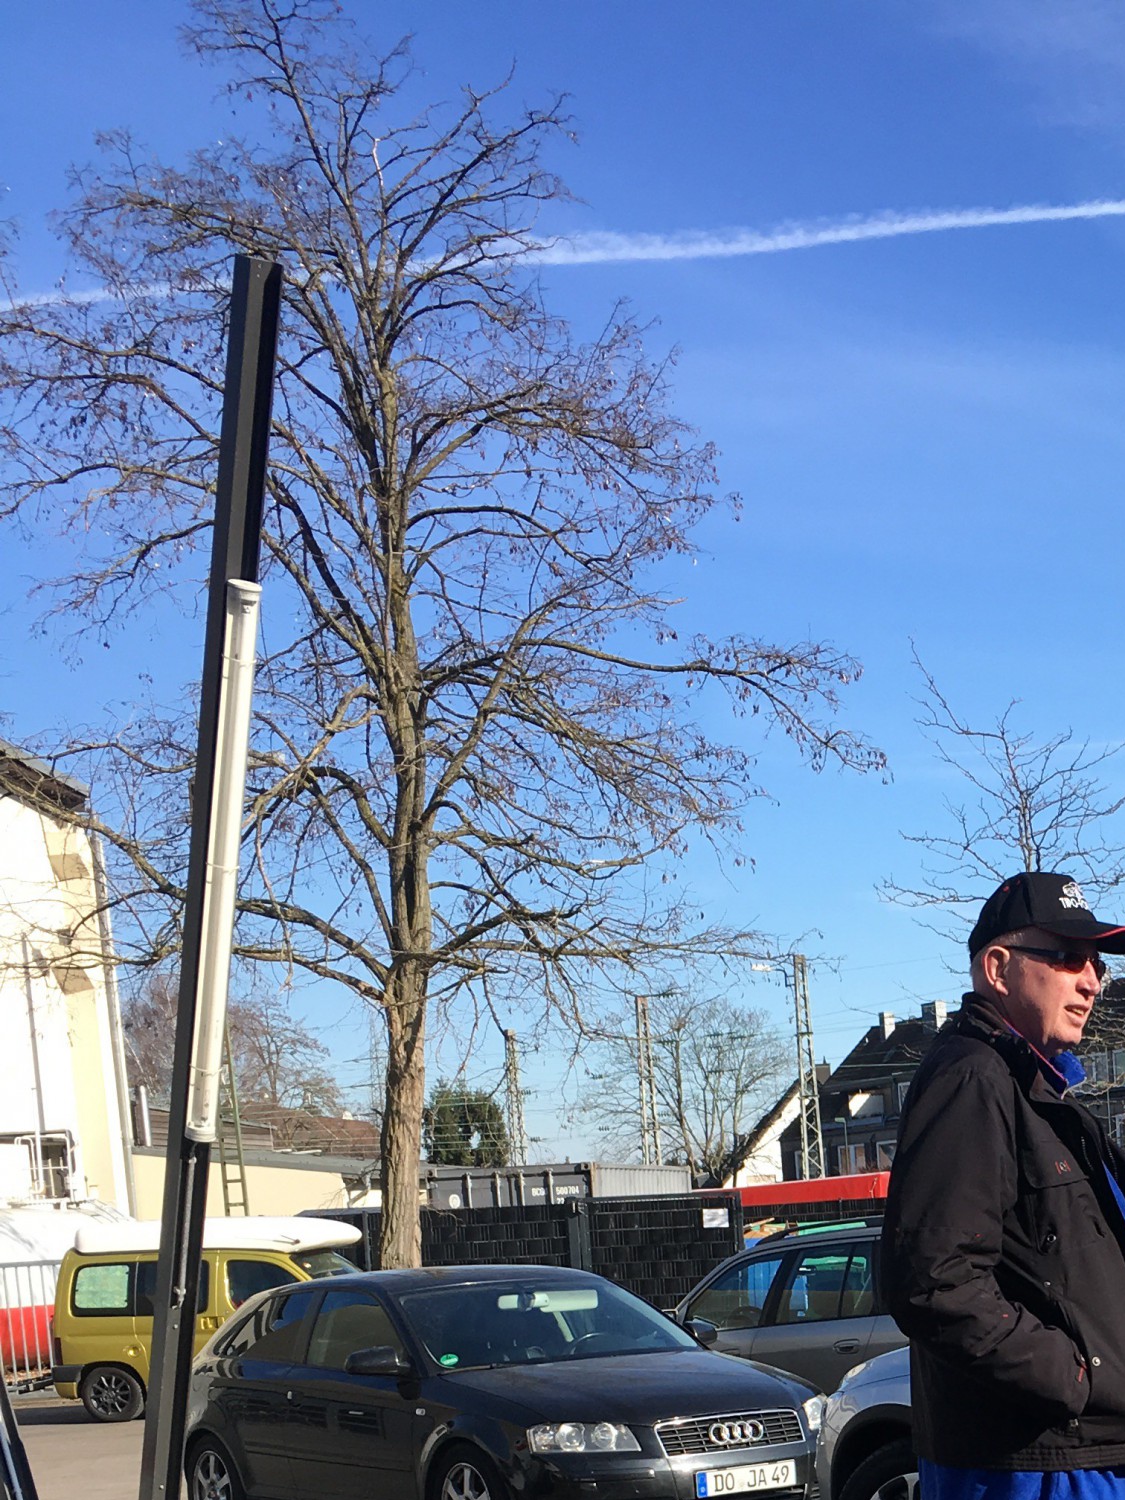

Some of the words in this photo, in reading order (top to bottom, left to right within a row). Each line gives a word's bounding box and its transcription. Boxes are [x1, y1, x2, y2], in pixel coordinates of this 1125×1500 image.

[714, 1472, 735, 1492] DO
[747, 1468, 768, 1488] JA
[771, 1465, 790, 1484] 49
